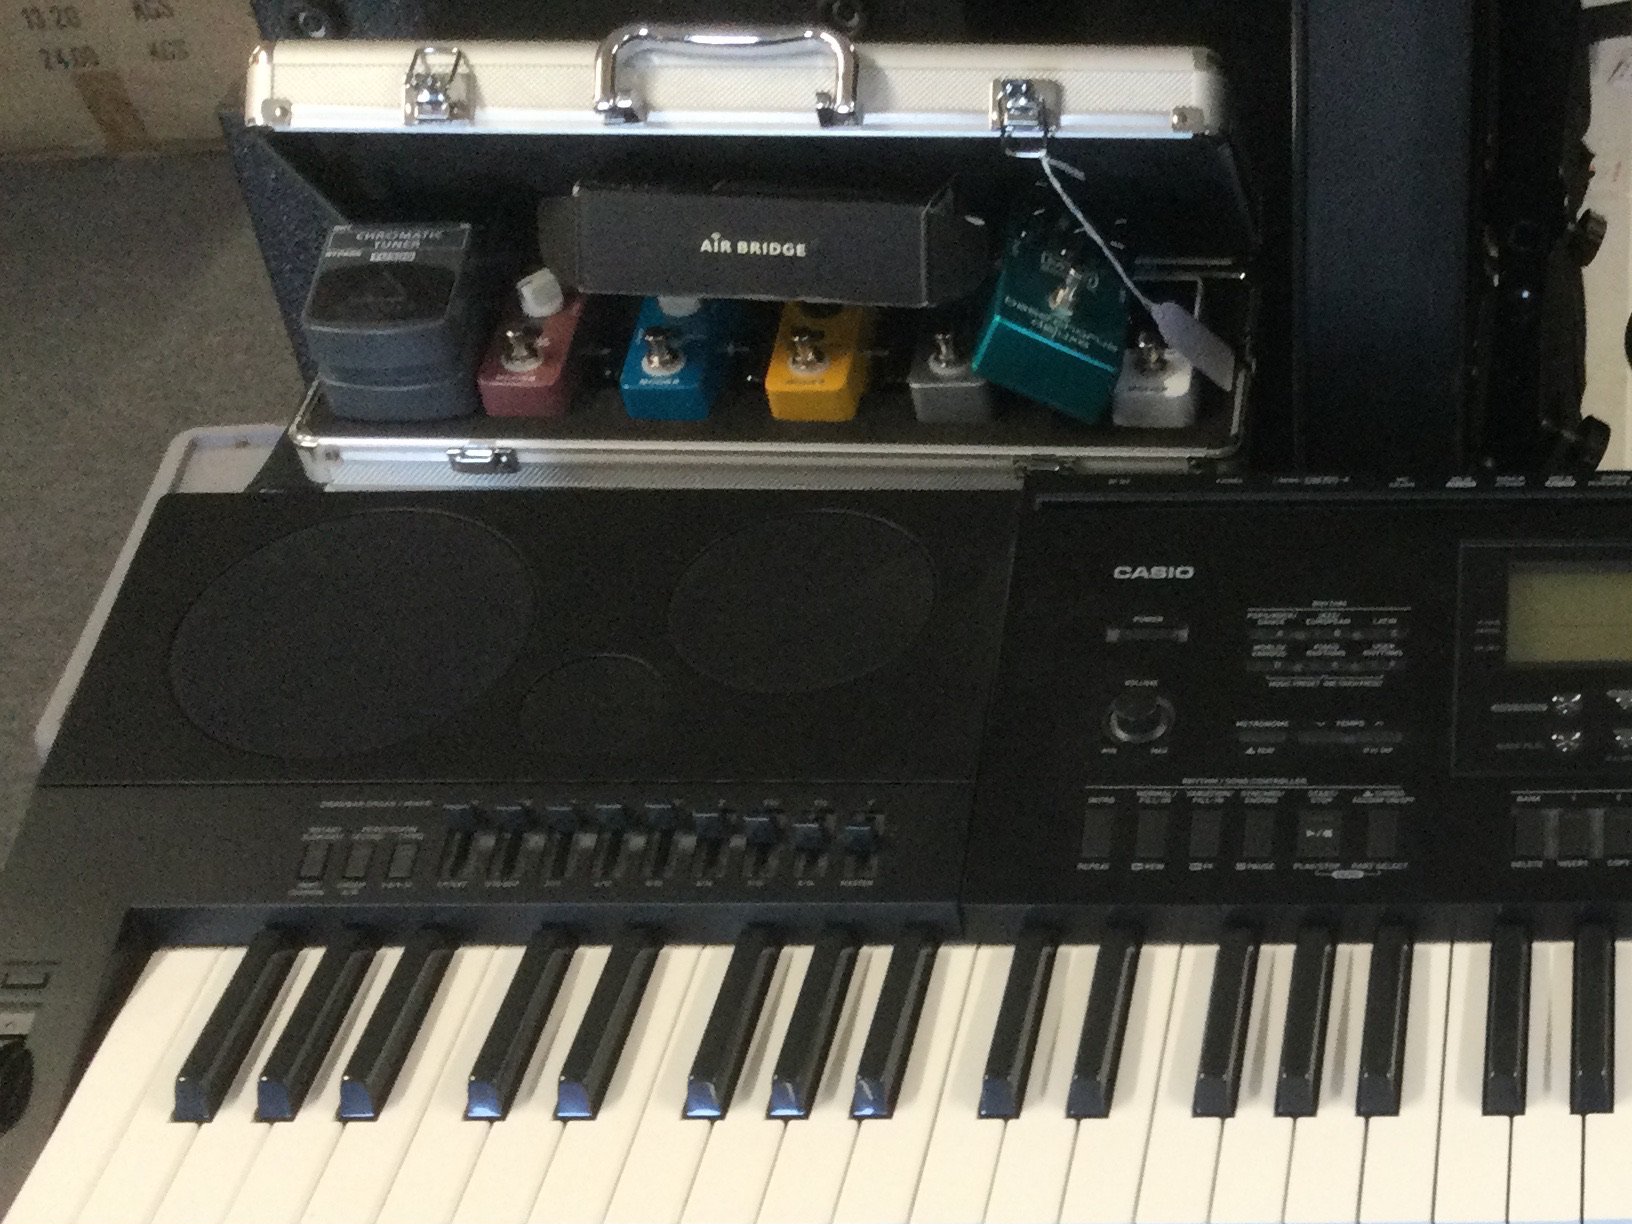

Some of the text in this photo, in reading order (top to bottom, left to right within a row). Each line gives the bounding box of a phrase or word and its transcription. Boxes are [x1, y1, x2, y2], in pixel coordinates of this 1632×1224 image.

[700, 231, 807, 258] AIR BRIDGE
[1113, 565, 1195, 580] CASIO
